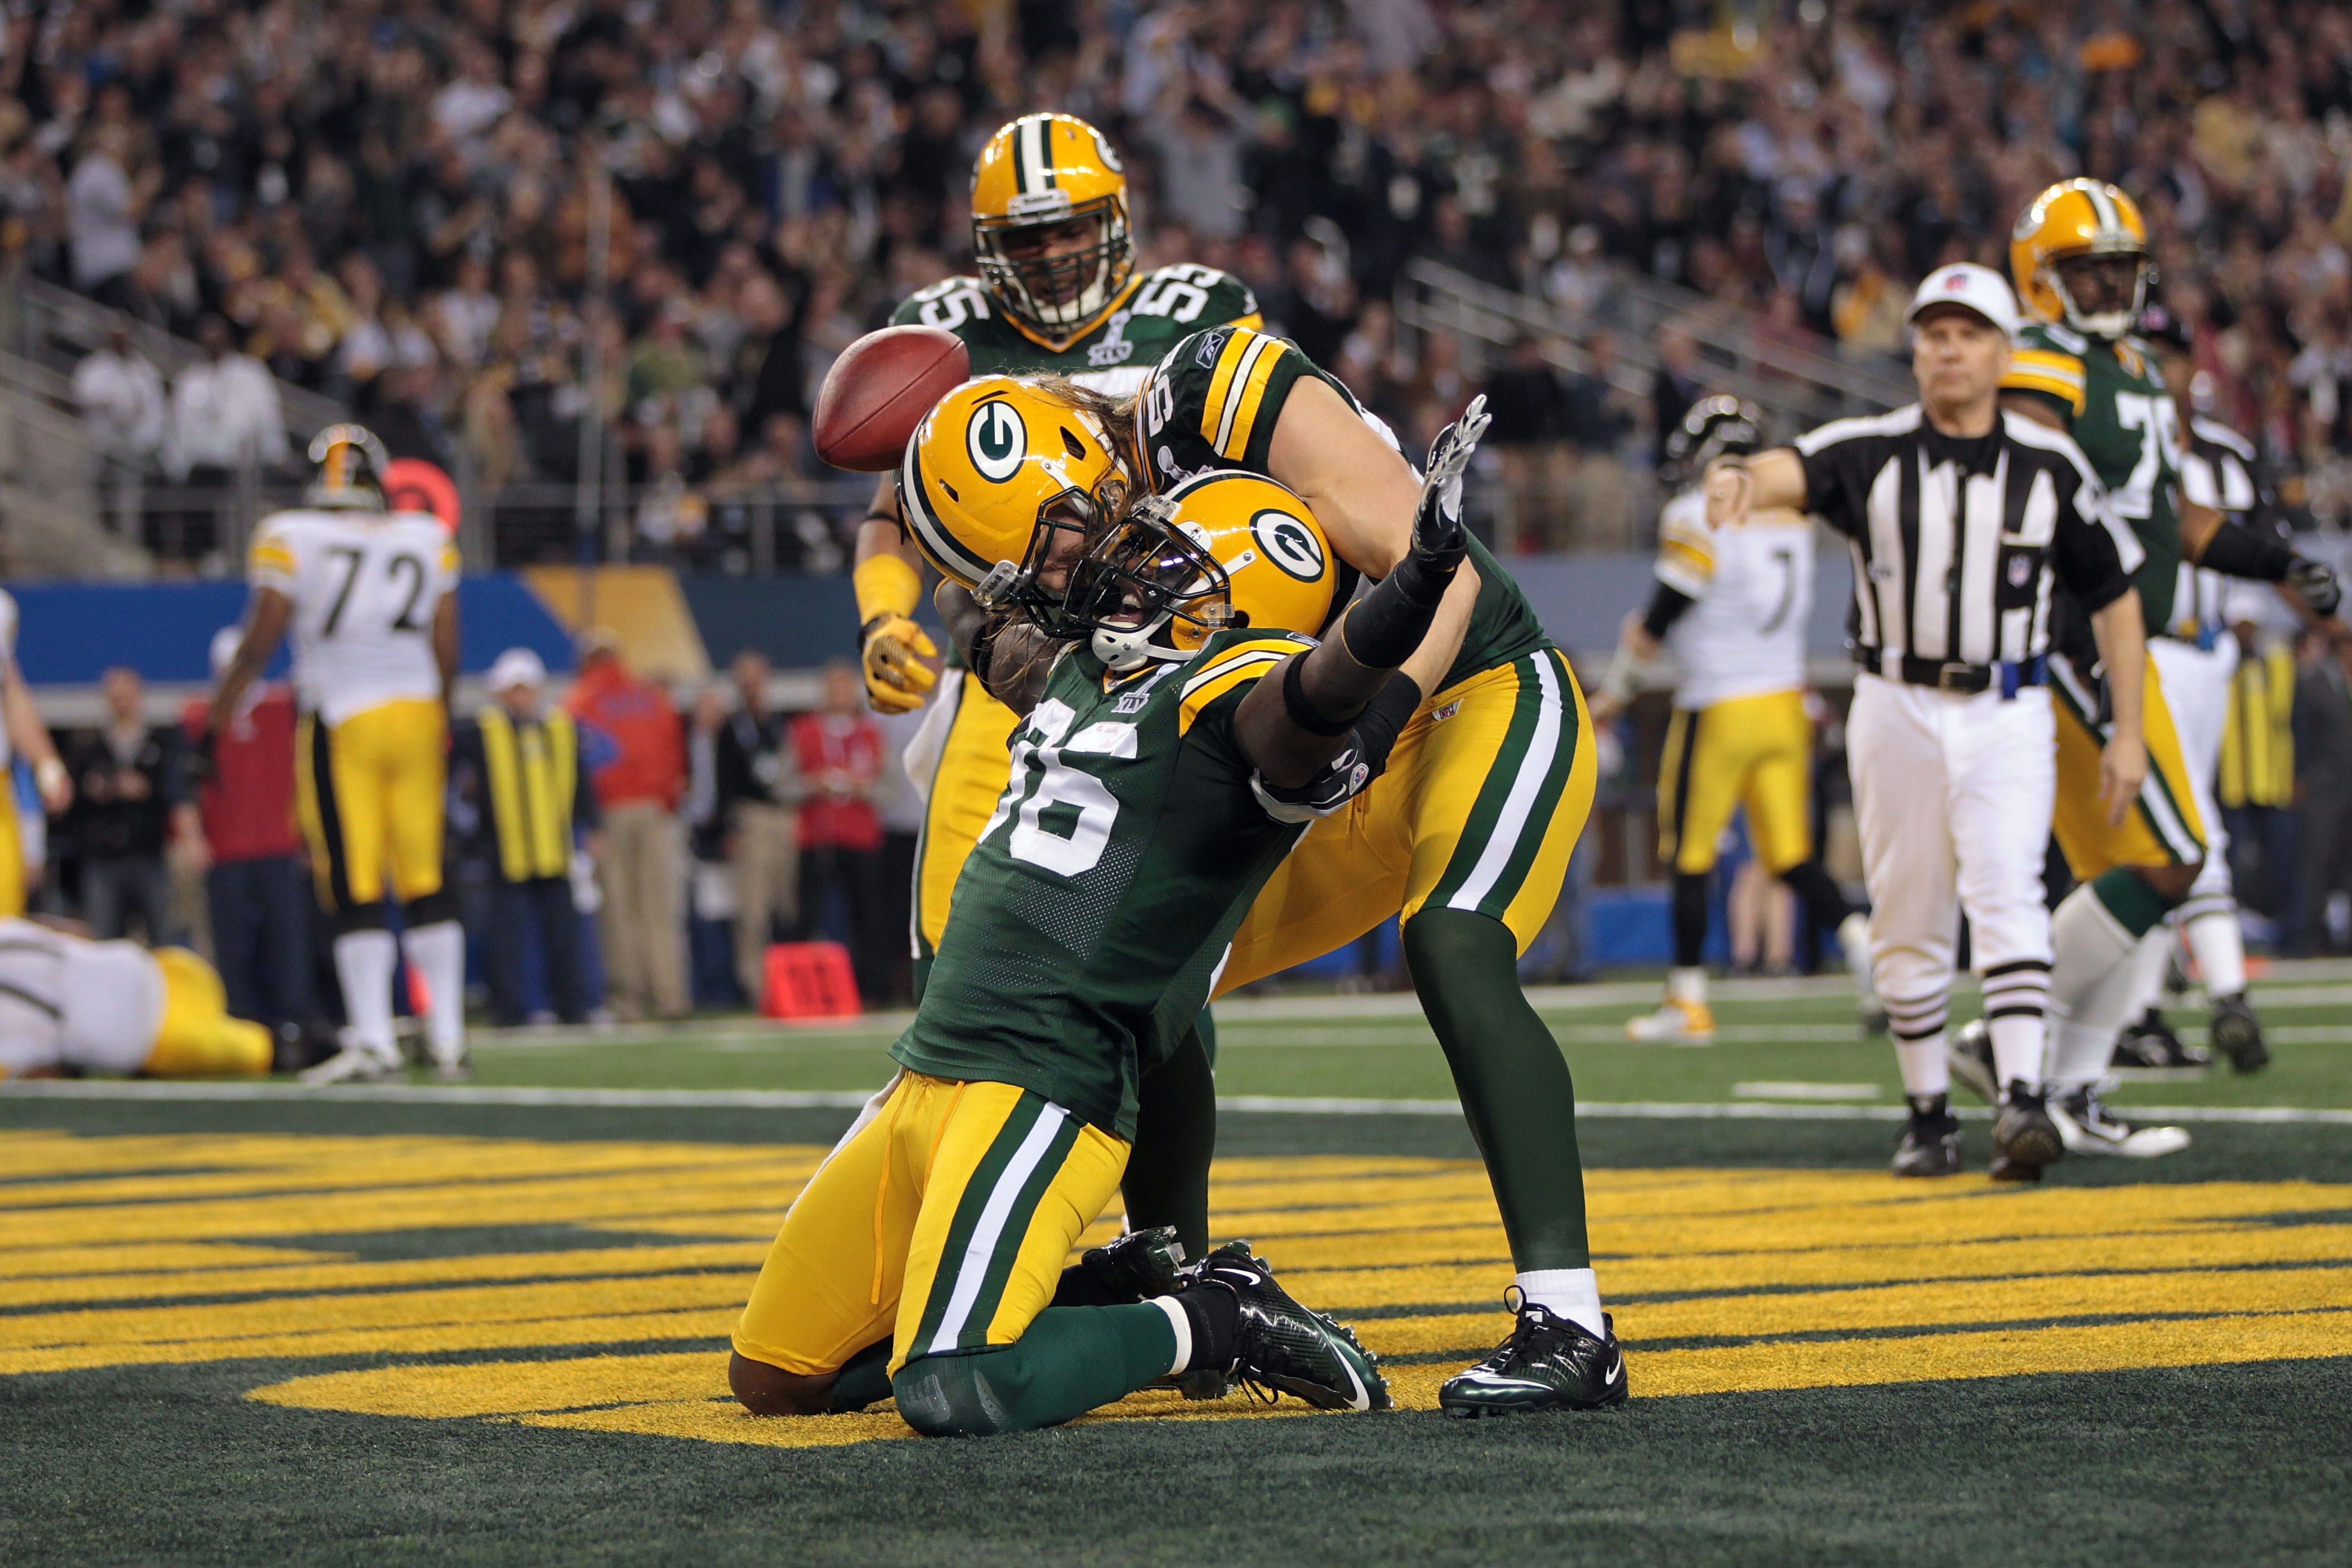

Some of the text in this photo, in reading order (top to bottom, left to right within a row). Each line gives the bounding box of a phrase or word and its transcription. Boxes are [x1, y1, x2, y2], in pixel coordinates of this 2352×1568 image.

[325, 547, 424, 637] 72
[1757, 548, 1797, 634] 7
[1440, 705, 1453, 718] NFL
